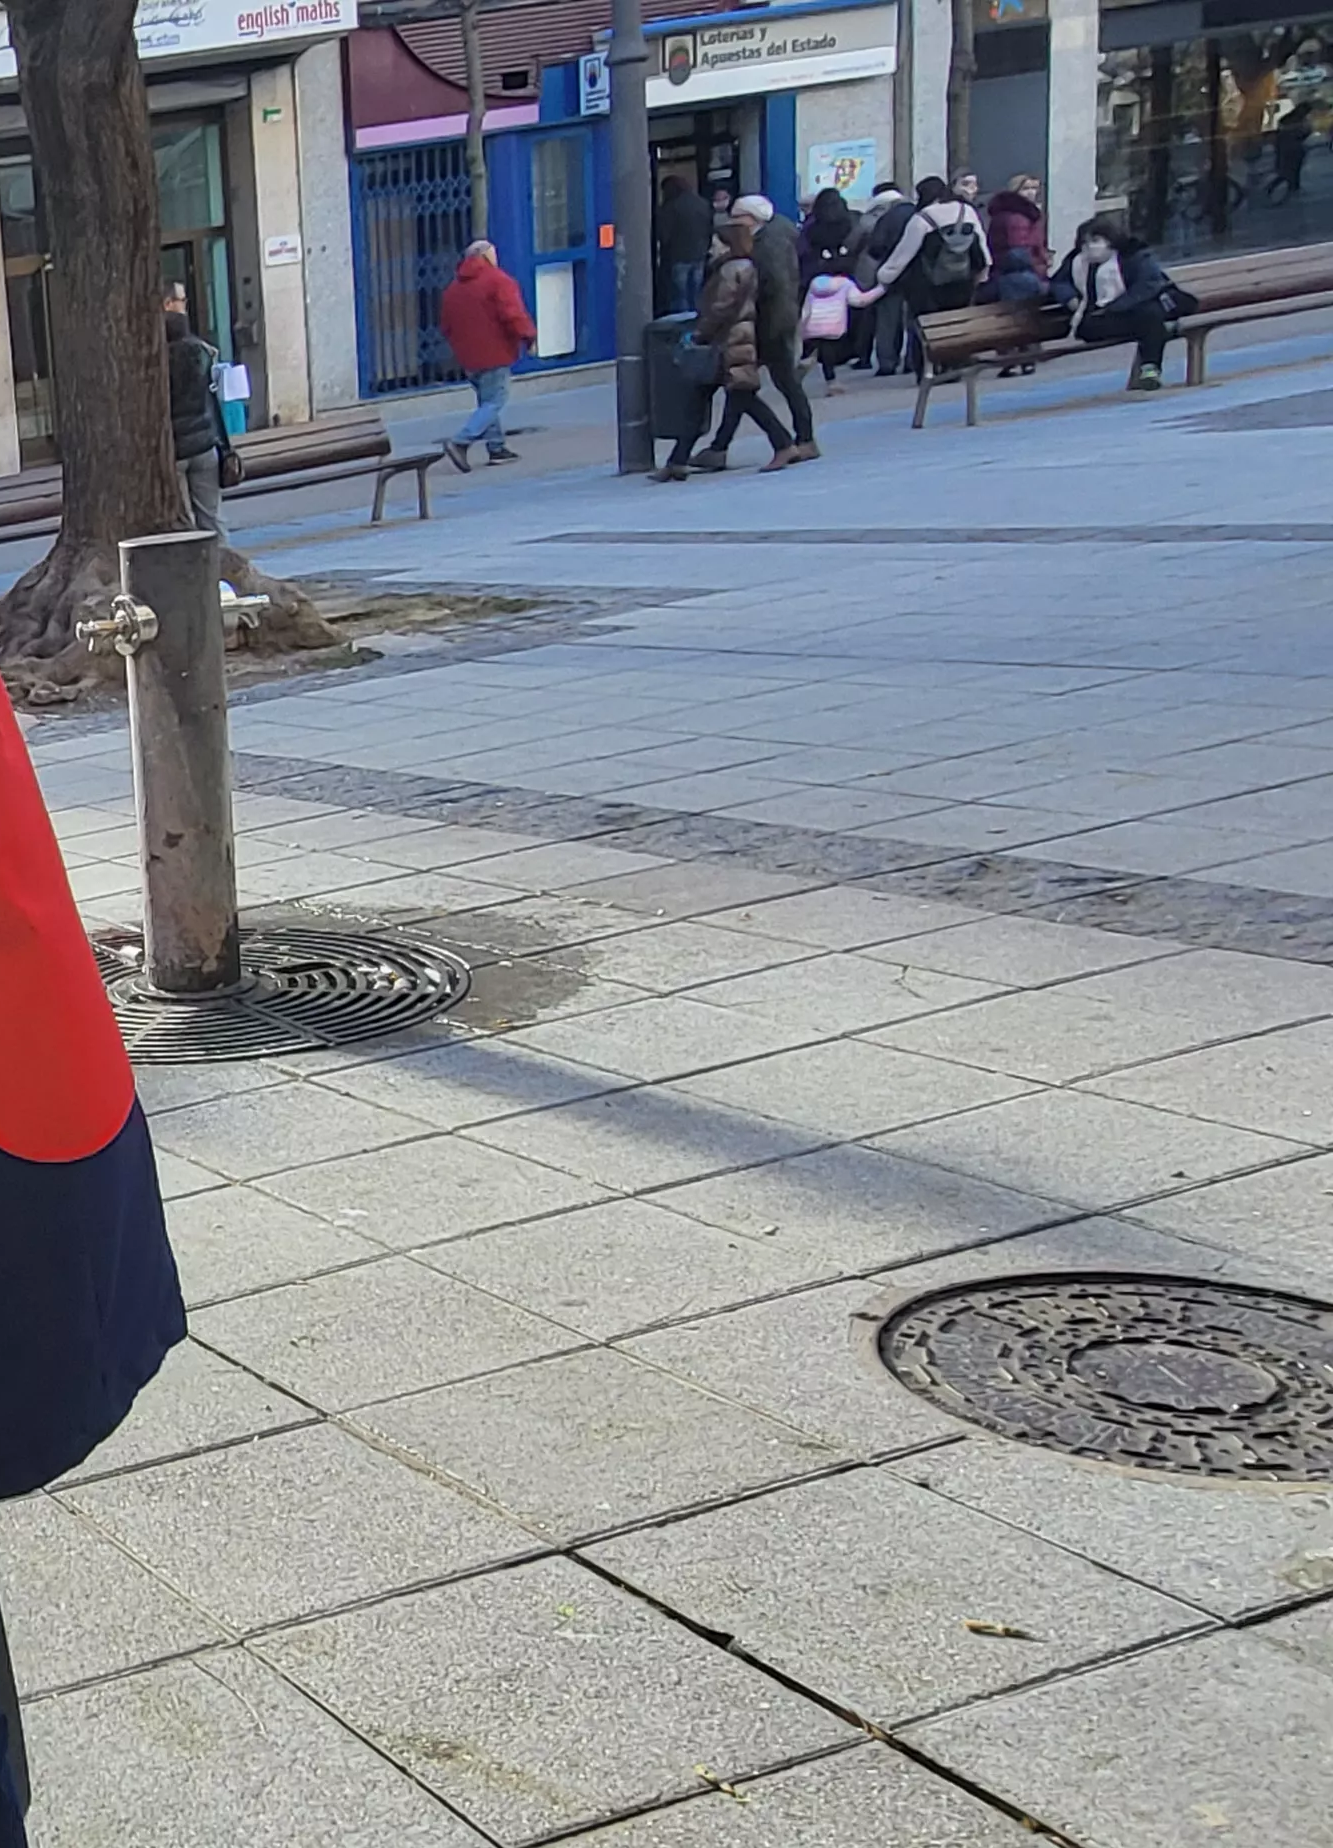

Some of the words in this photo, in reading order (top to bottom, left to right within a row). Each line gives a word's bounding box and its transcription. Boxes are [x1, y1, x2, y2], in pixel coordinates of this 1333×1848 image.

[238, 4, 290, 37] english
[296, 0, 341, 22] maths
[759, 27, 768, 42] y
[700, 46, 762, 68] Apuestas
[767, 40, 787, 56] del
[791, 33, 836, 54] Estado
